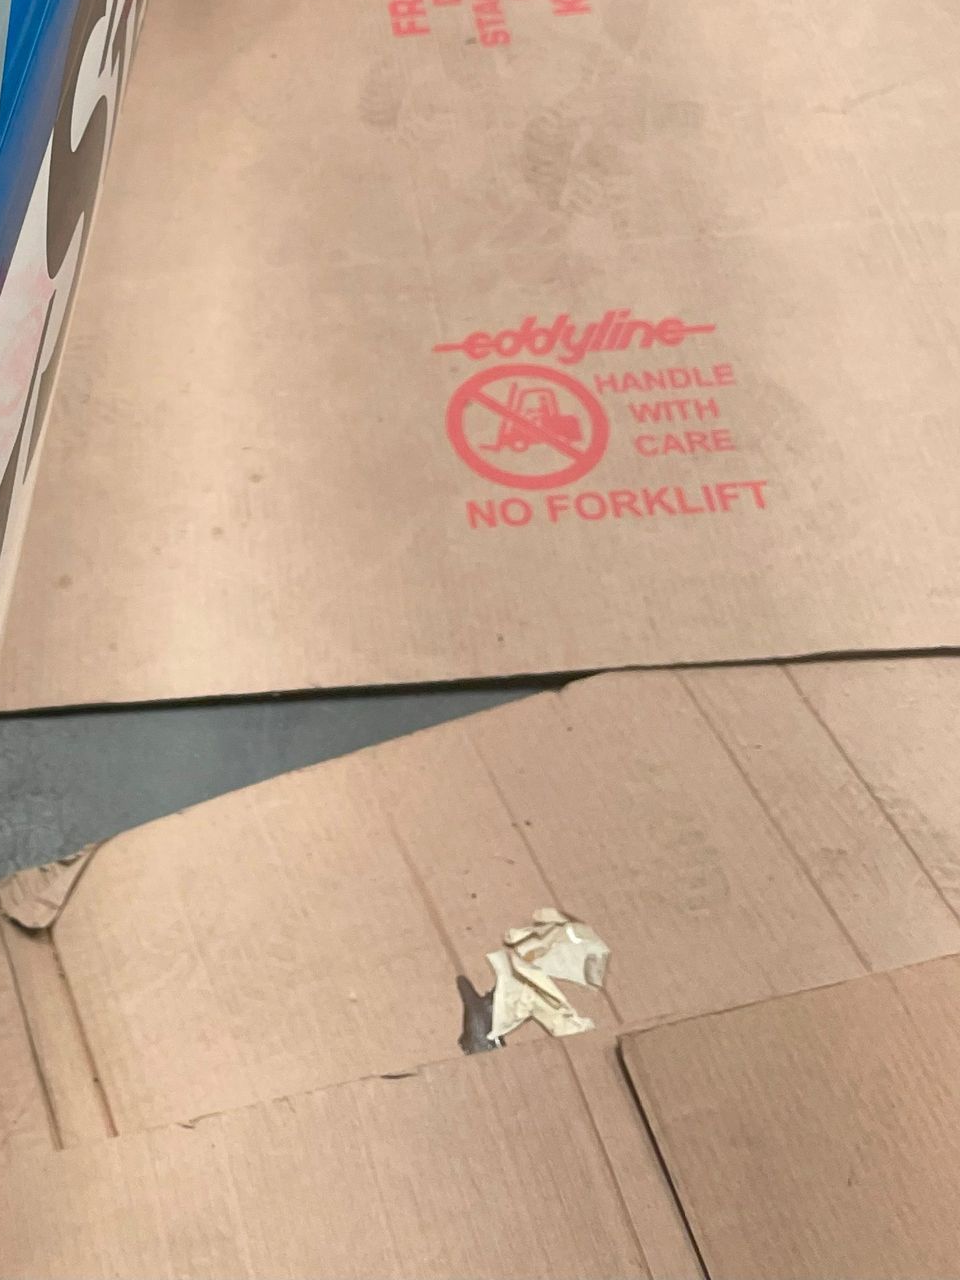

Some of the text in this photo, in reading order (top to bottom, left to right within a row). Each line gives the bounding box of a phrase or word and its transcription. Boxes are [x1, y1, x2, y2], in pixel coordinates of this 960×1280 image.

[593, 363, 737, 394] HANDLE
[629, 398, 720, 424] WITH
[634, 429, 736, 457] CARE
[466, 480, 767, 529] NO FORKLIFT
